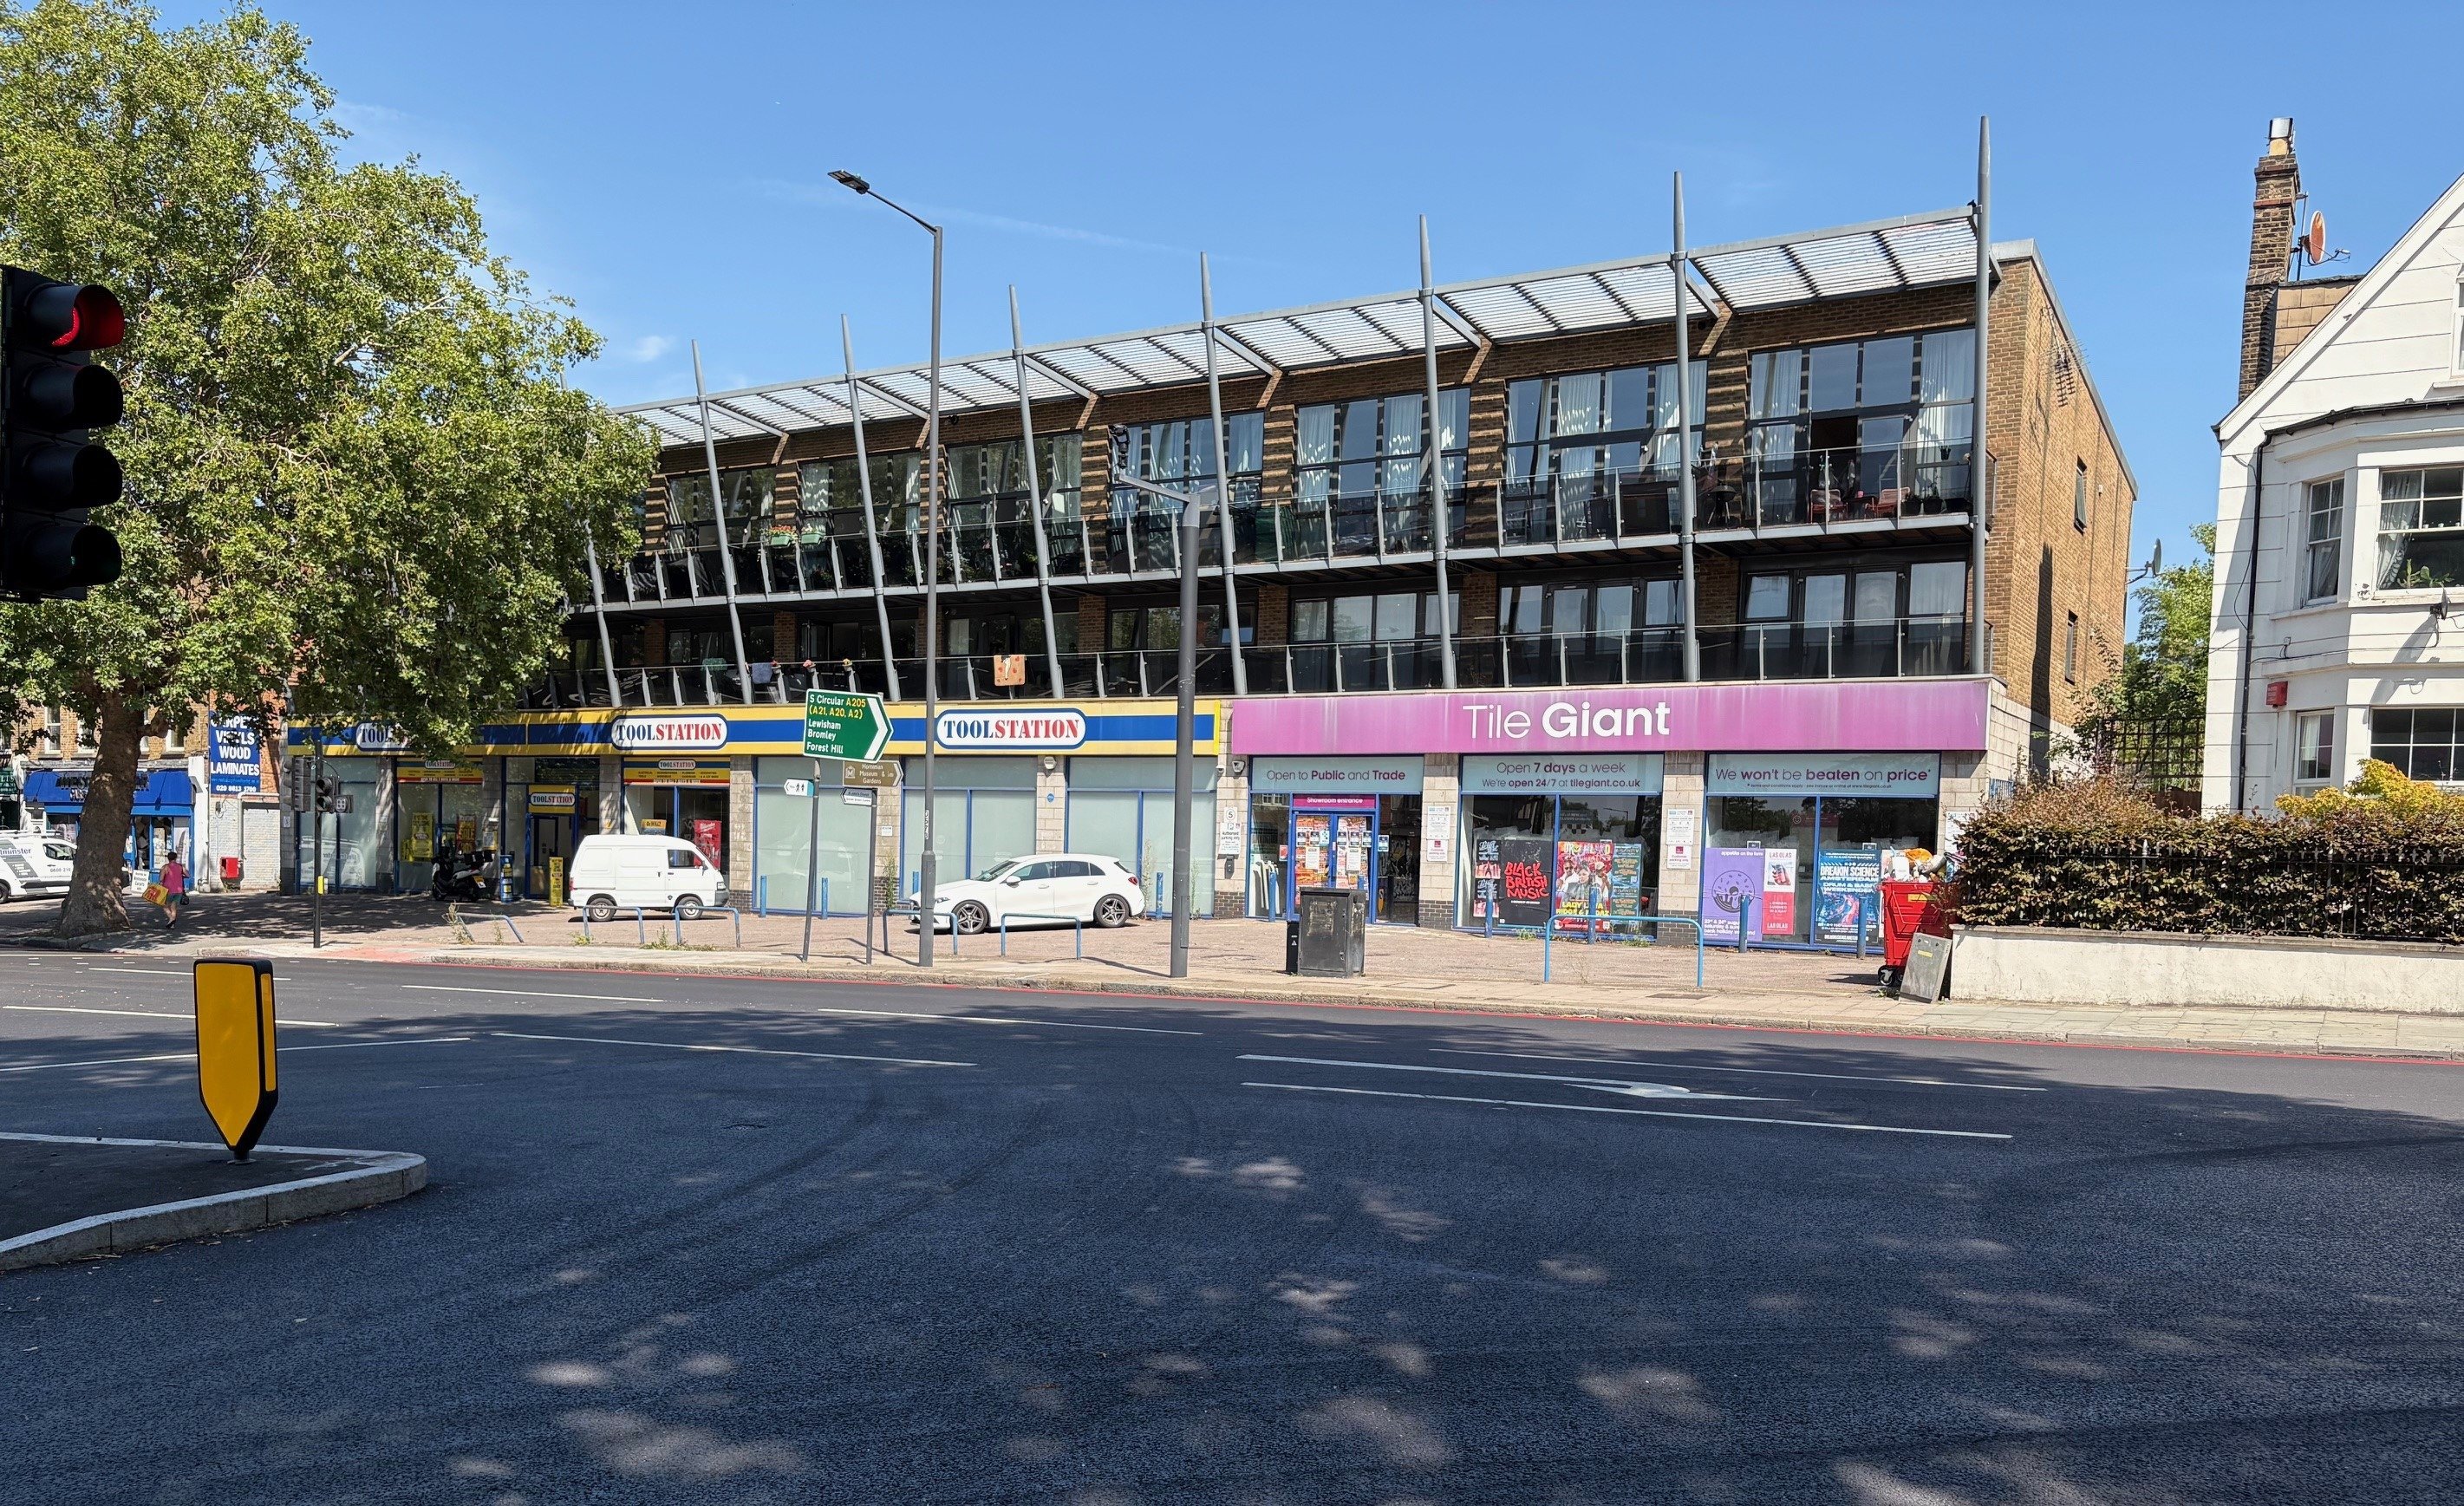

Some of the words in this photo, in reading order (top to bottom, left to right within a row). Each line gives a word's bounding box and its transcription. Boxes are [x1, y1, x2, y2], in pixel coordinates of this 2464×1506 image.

[809, 694, 815, 703] S
[817, 695, 844, 706] Circular
[846, 698, 866, 707] A205
[848, 709, 864, 720] A2)
[1463, 704, 1531, 738] Tile
[1542, 701, 1670, 738] Giant
[808, 719, 842, 730] Lewisham
[944, 720, 1079, 738] TOOLSTATION
[616, 723, 722, 740] TOOLSTATION
[807, 729, 837, 741] Bromley
[219, 746, 251, 760] WOOD
[806, 742, 829, 753] Forest
[831, 744, 844, 754] Hill
[211, 762, 259, 776] LAMINATES
[1496, 762, 1531, 775] Open
[1534, 763, 1541, 773] 7
[1544, 762, 1575, 775] days
[1579, 764, 1588, 773] a
[1591, 762, 1626, 773] week
[1716, 769, 1737, 780] We
[1741, 769, 1778, 780] won't
[1783, 769, 1802, 780] be
[1806, 769, 1860, 780] beaten
[1865, 771, 1883, 781] on
[1267, 771, 1295, 781] Open
[1299, 771, 1308, 779] to
[1311, 770, 1345, 780] Public
[1348, 771, 1370, 780] and
[1372, 770, 1405, 780] Trade
[1509, 780, 1533, 789] open
[1570, 779, 1640, 789] tilegiant.co.uk
[1504, 861, 1542, 877] BLACK
[1850, 867, 1879, 877] SCIENCE
[1507, 887, 1549, 900] MUSIC
